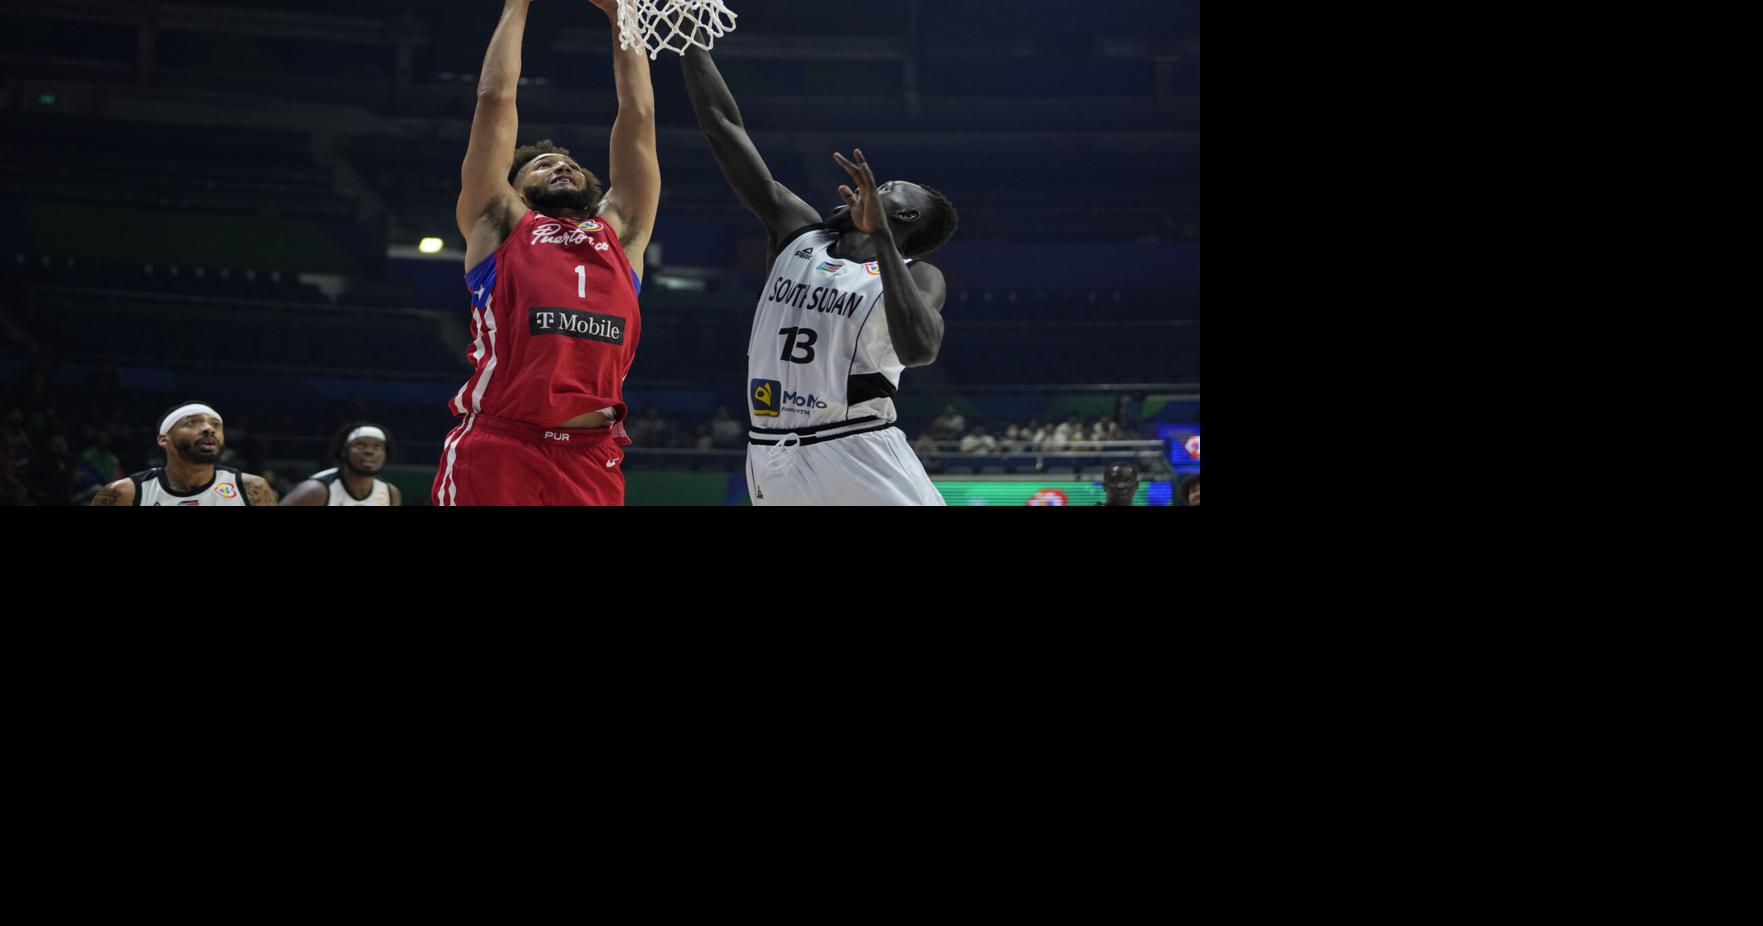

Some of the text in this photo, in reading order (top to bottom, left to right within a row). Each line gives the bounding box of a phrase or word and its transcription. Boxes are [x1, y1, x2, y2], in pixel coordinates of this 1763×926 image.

[531, 223, 587, 245] Puerto
[574, 265, 586, 298] 1
[807, 287, 863, 318] SUDAN
[559, 313, 620, 339] Mobile
[778, 326, 818, 364] 13
[544, 431, 570, 442] PUR
